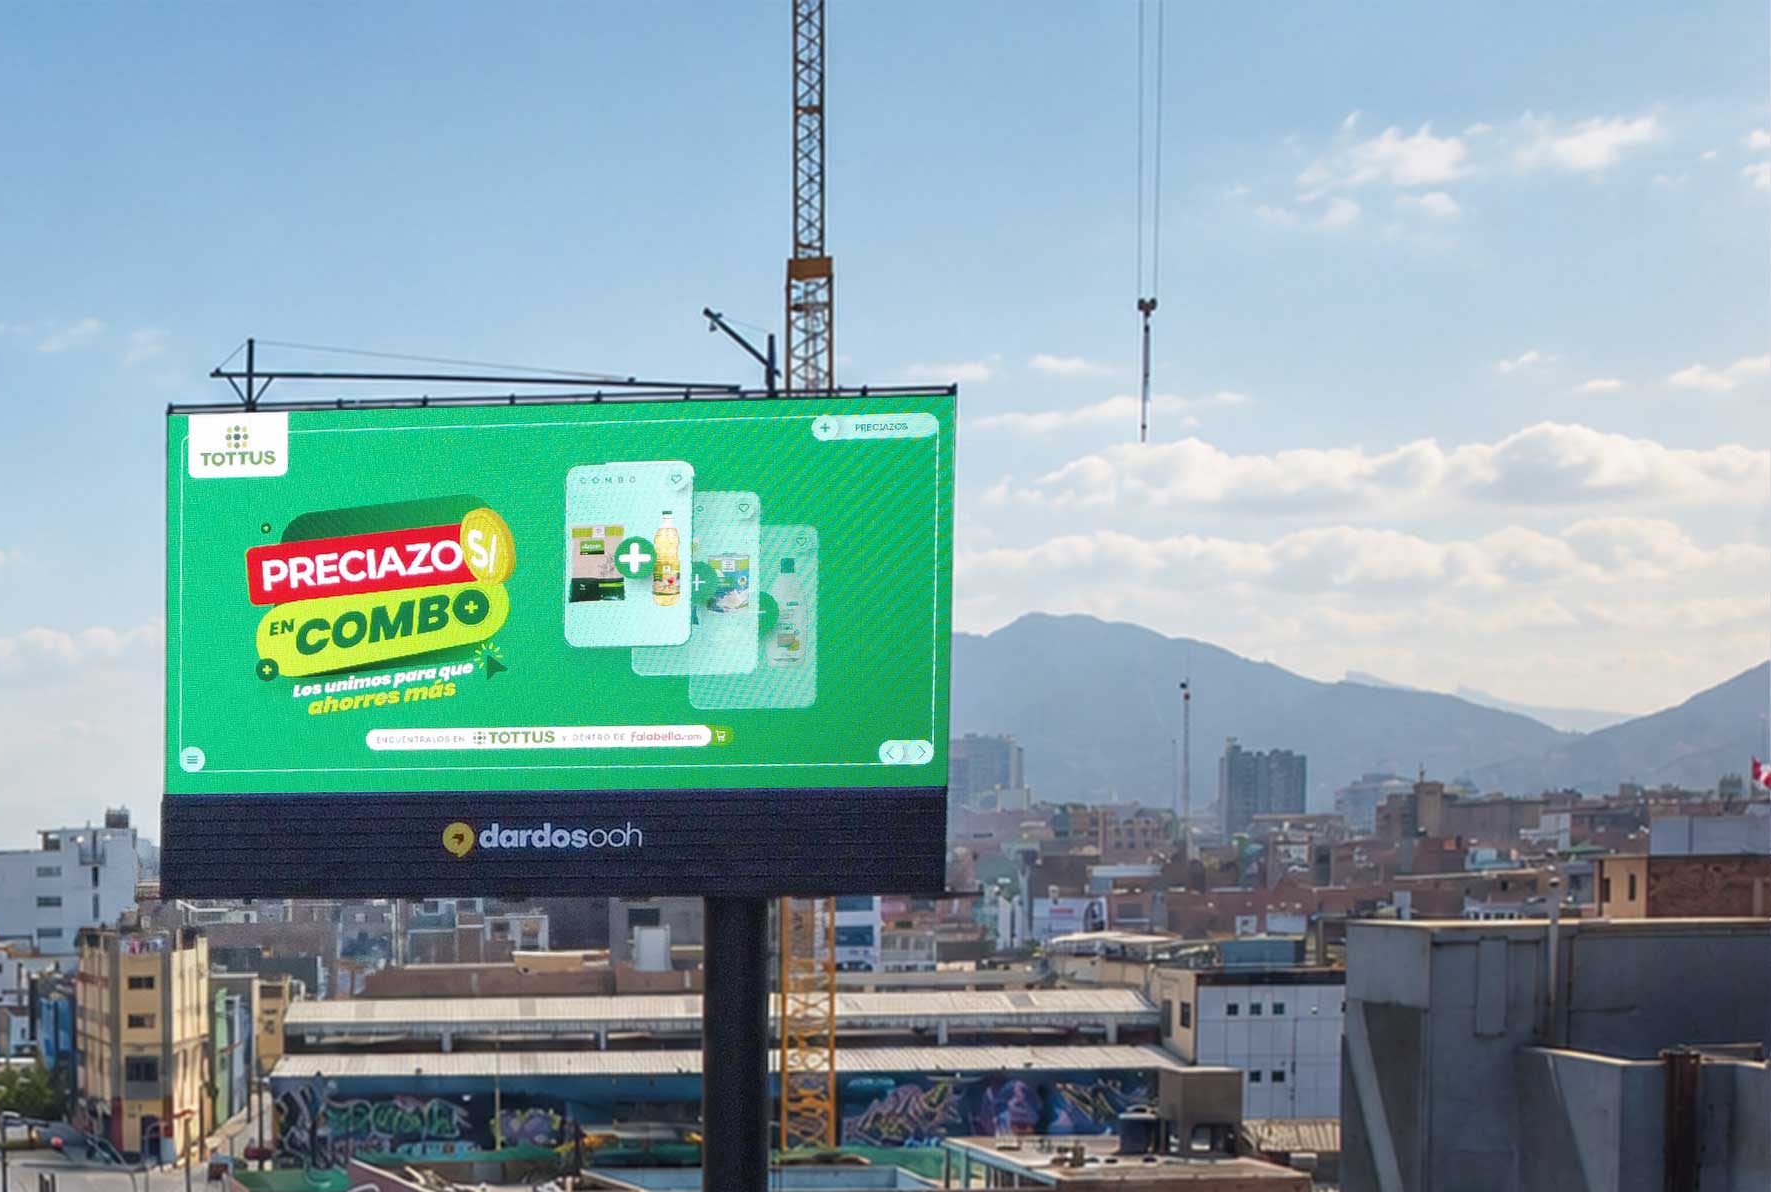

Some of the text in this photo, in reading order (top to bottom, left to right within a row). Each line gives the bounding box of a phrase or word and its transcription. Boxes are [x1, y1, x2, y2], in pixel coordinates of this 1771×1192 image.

[855, 423, 909, 432] PRECIAZOS
[200, 450, 276, 467] TOTTUS
[269, 588, 491, 656] EN COMBO
[292, 662, 474, 698] Los unimos para que
[307, 679, 457, 716] ahorres más
[453, 735, 465, 743] EN
[489, 730, 555, 744] TOTTUS
[572, 733, 610, 742] DENTRO
[613, 733, 626, 741] DE
[630, 731, 703, 743] falabella.com
[478, 821, 643, 848] dardosooh
